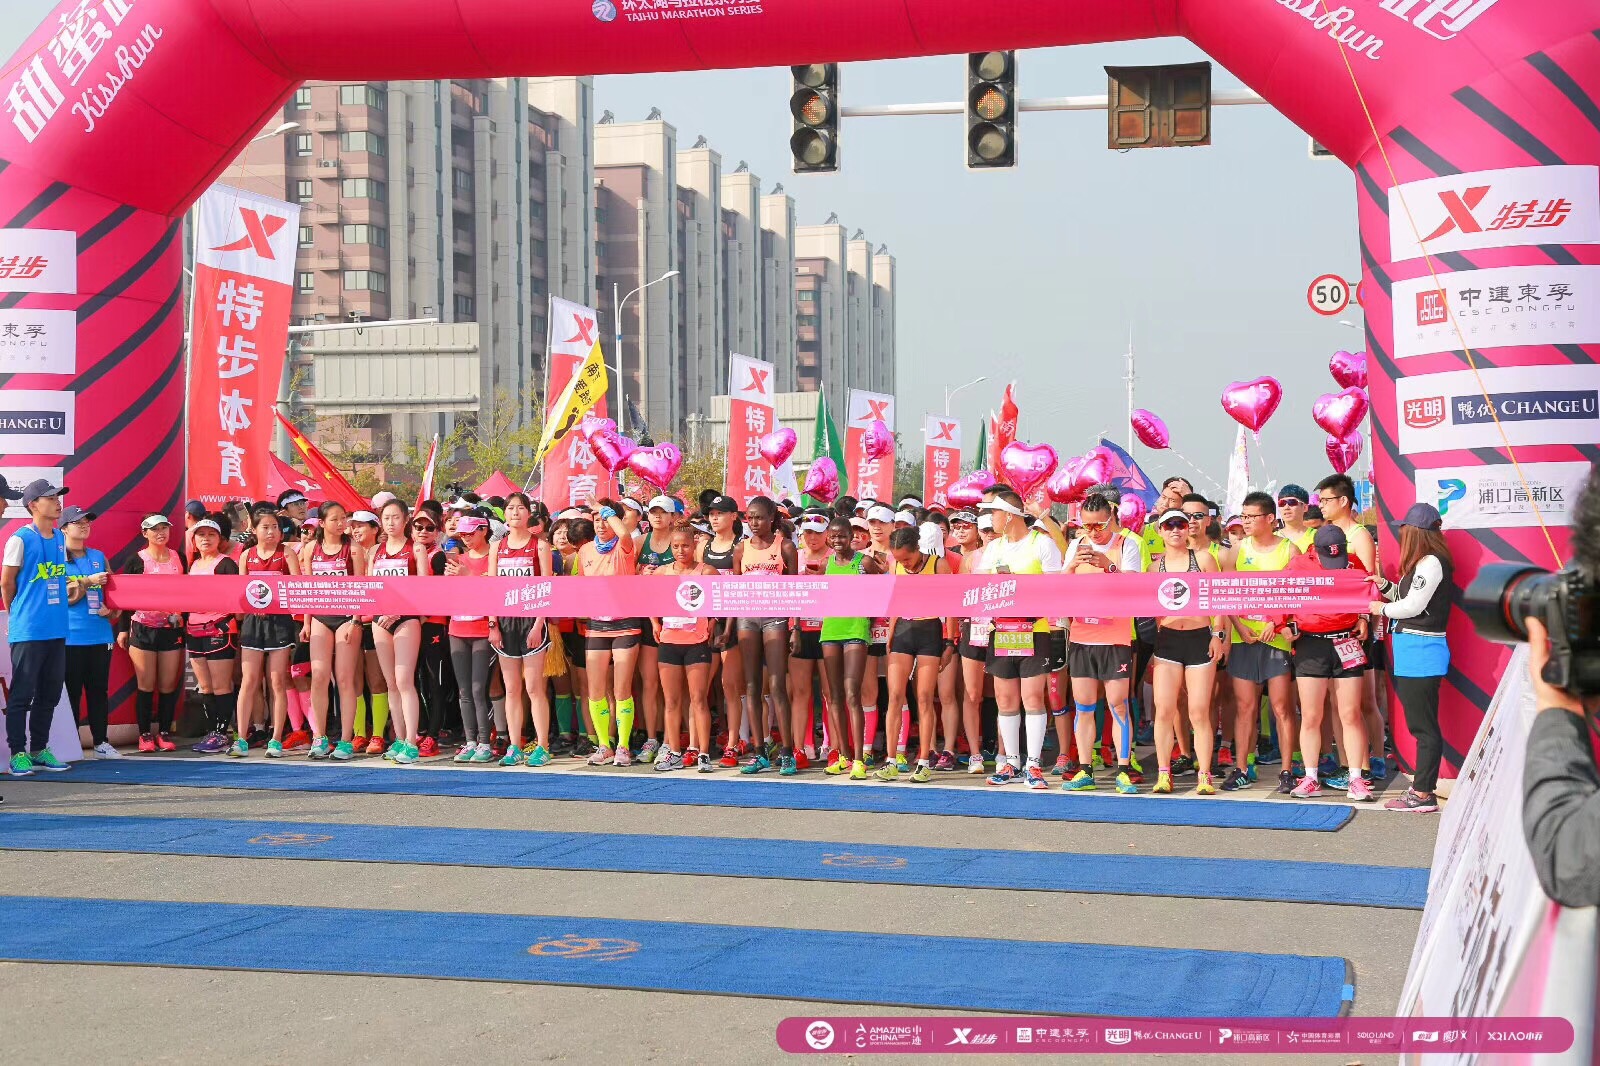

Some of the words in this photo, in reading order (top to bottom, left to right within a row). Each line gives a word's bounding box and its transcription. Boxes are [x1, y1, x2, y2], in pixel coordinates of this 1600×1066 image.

[625, 12, 659, 22] TAIHU
[661, 8, 725, 20] MARATHON
[727, 5, 763, 16] SERIES
[1484, 198, 1572, 232] 特步
[1316, 285, 1342, 304] 50
[216, 279, 264, 487] 特步体育
[1406, 398, 1443, 420] 光明
[1478, 486, 1565, 505] 浦口高新区
[499, 567, 532, 577] A004
[504, 581, 552, 608] 甜蜜跑
[962, 580, 1017, 608] 甜蜜跑
[997, 632, 1033, 645] 30318
